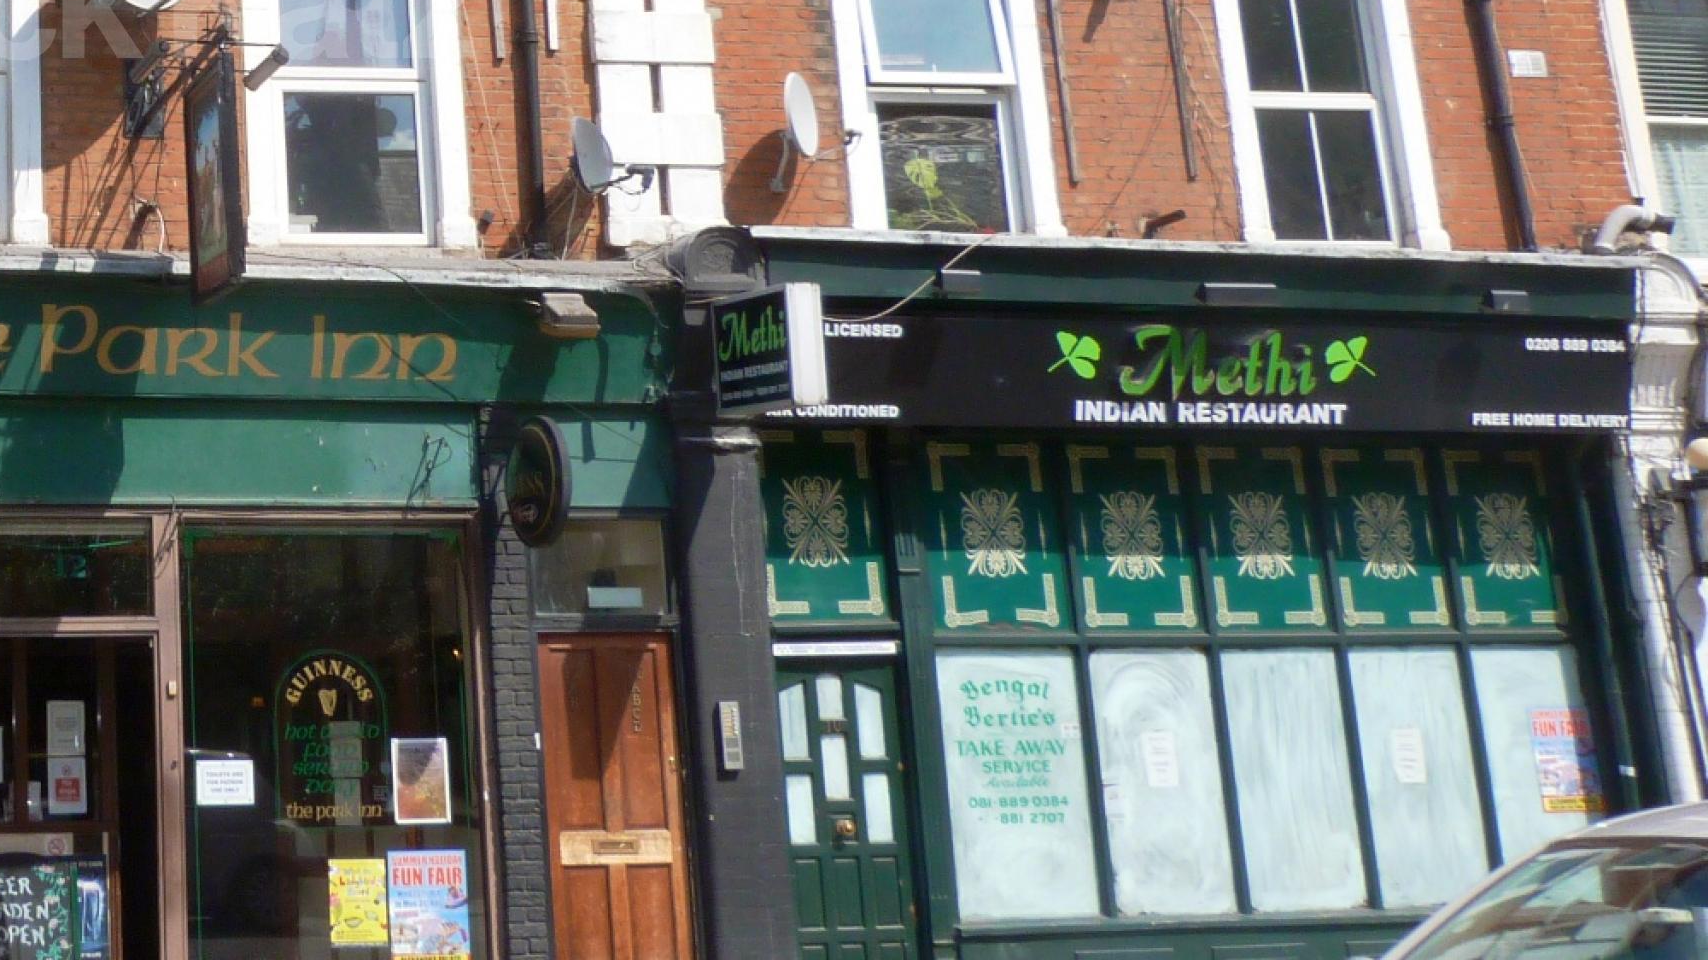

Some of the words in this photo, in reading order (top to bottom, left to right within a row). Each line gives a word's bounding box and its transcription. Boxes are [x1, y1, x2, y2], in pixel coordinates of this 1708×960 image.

[718, 304, 787, 362] Methi
[823, 323, 903, 338] LICENSED
[40, 303, 280, 378] Park
[311, 314, 458, 381] Inn
[1119, 324, 1317, 401] Methi
[795, 404, 900, 418] CONDITIONED
[1075, 400, 1166, 423] INDIAN
[1177, 401, 1347, 425] RESTAURANT
[1472, 412, 1509, 426] FREE
[1512, 413, 1556, 427] HOME
[1558, 414, 1629, 428] DELIVERY
[286, 659, 374, 704] GUINNESS
[959, 679, 1050, 702] Bengal
[963, 705, 1055, 727] Bertie's
[1533, 720, 1556, 736] FUN
[954, 739, 1005, 756] TAKE
[1013, 739, 1066, 756] AWAY
[982, 760, 1052, 774] SERVICE
[286, 801, 313, 819] the
[1032, 796, 1069, 808] 0384
[1030, 812, 1065, 824] 2707
[392, 868, 423, 886] FUN
[428, 867, 462, 886] FAIR
